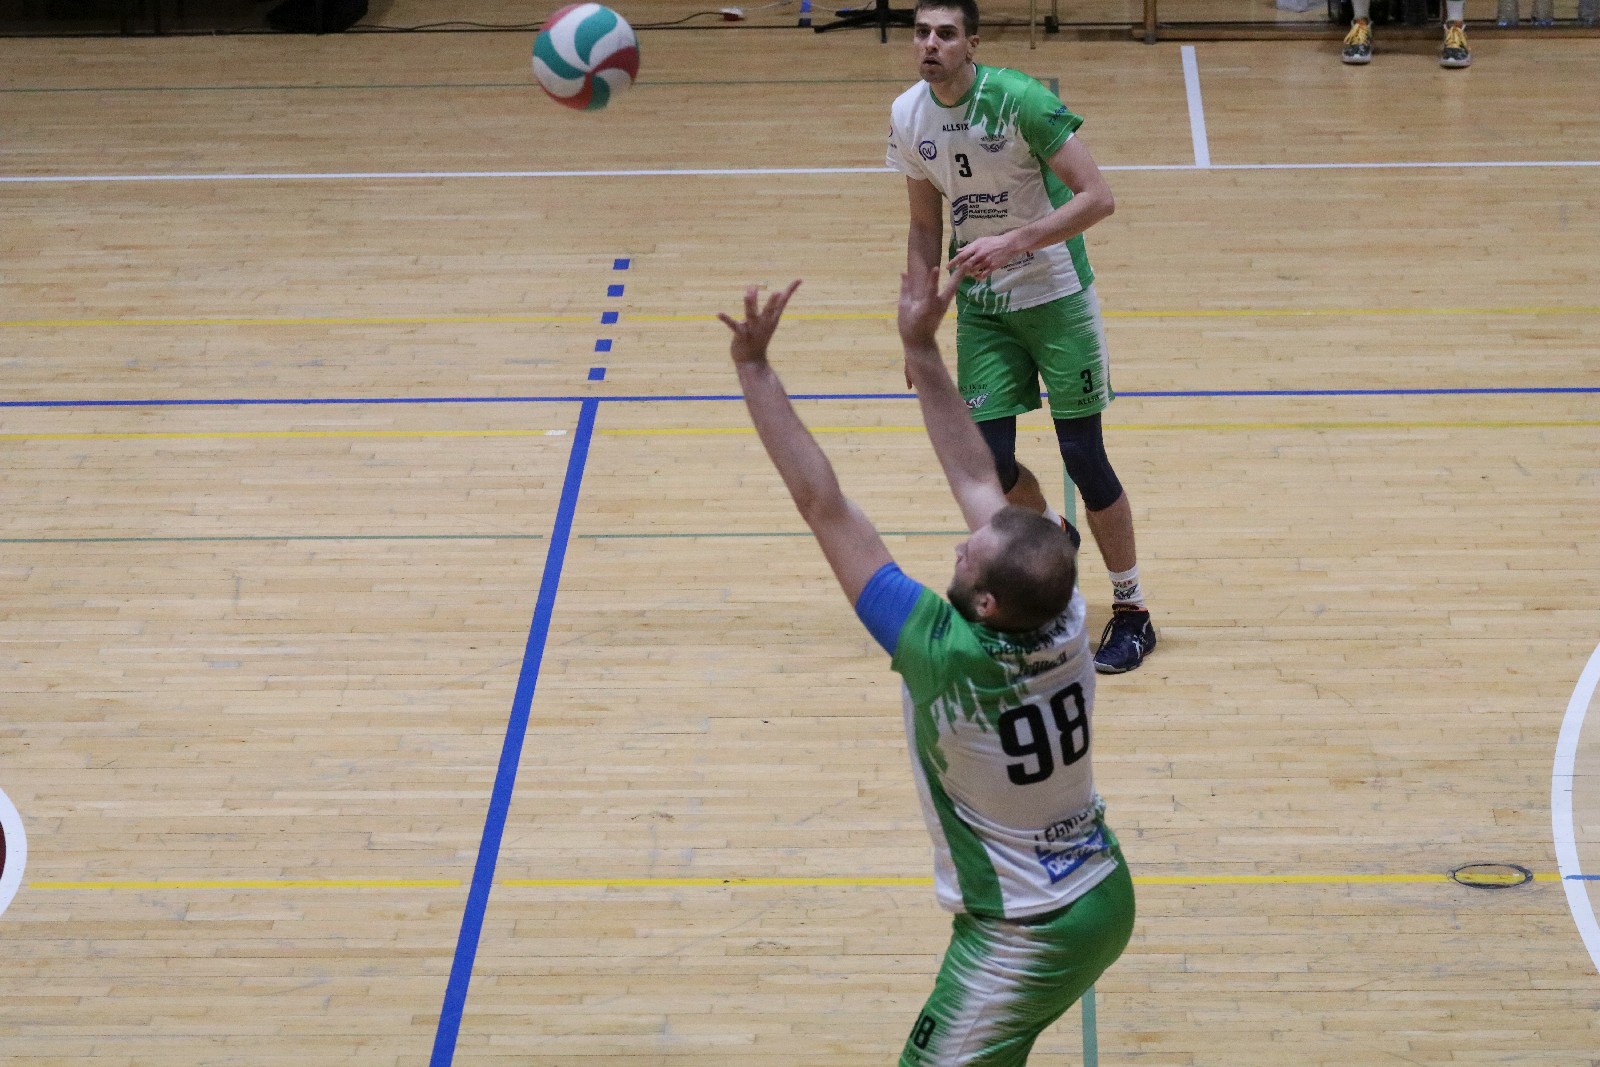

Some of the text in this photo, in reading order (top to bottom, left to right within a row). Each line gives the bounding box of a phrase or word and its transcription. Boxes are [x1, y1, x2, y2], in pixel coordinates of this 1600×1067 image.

[942, 123, 969, 132] ALLSIX
[954, 153, 973, 178] 3
[1079, 368, 1094, 394] 3
[997, 682, 1089, 786] 98
